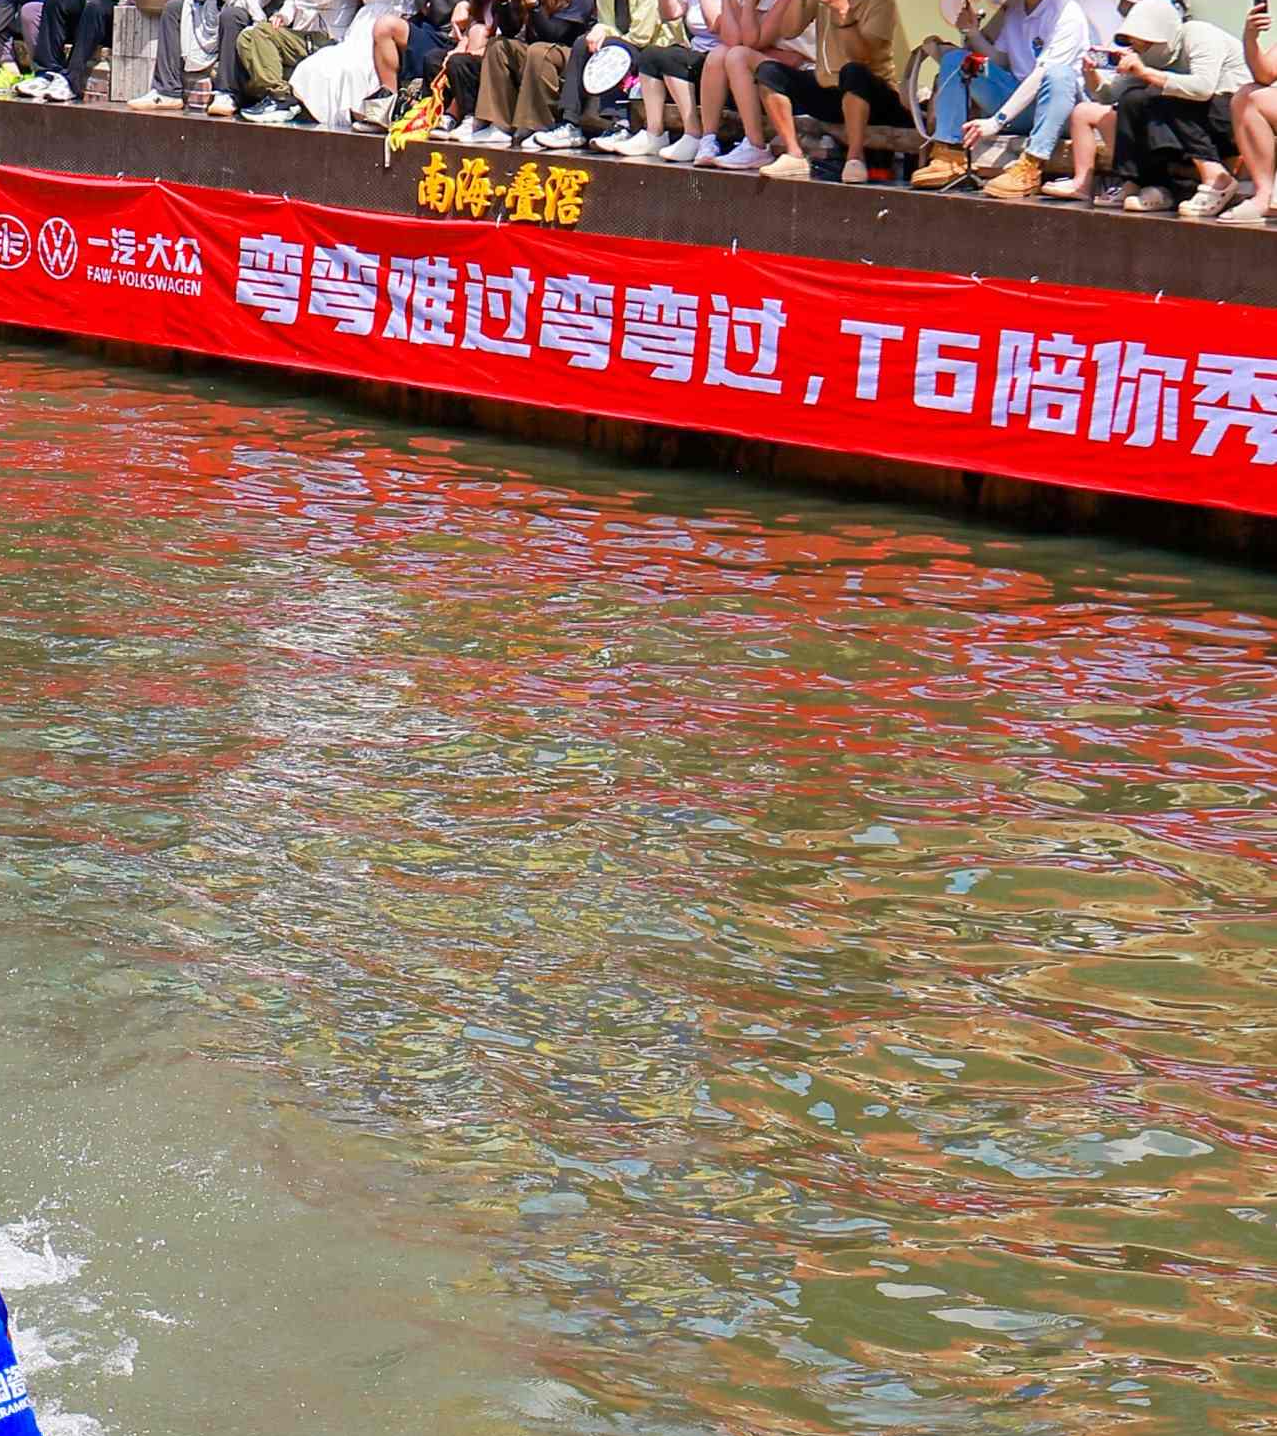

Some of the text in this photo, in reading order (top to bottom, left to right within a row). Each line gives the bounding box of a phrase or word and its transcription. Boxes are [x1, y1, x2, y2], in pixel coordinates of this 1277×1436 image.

[86, 226, 203, 276] 一汽·大众
[86, 264, 202, 298] FAW-VOLKSWAGEN
